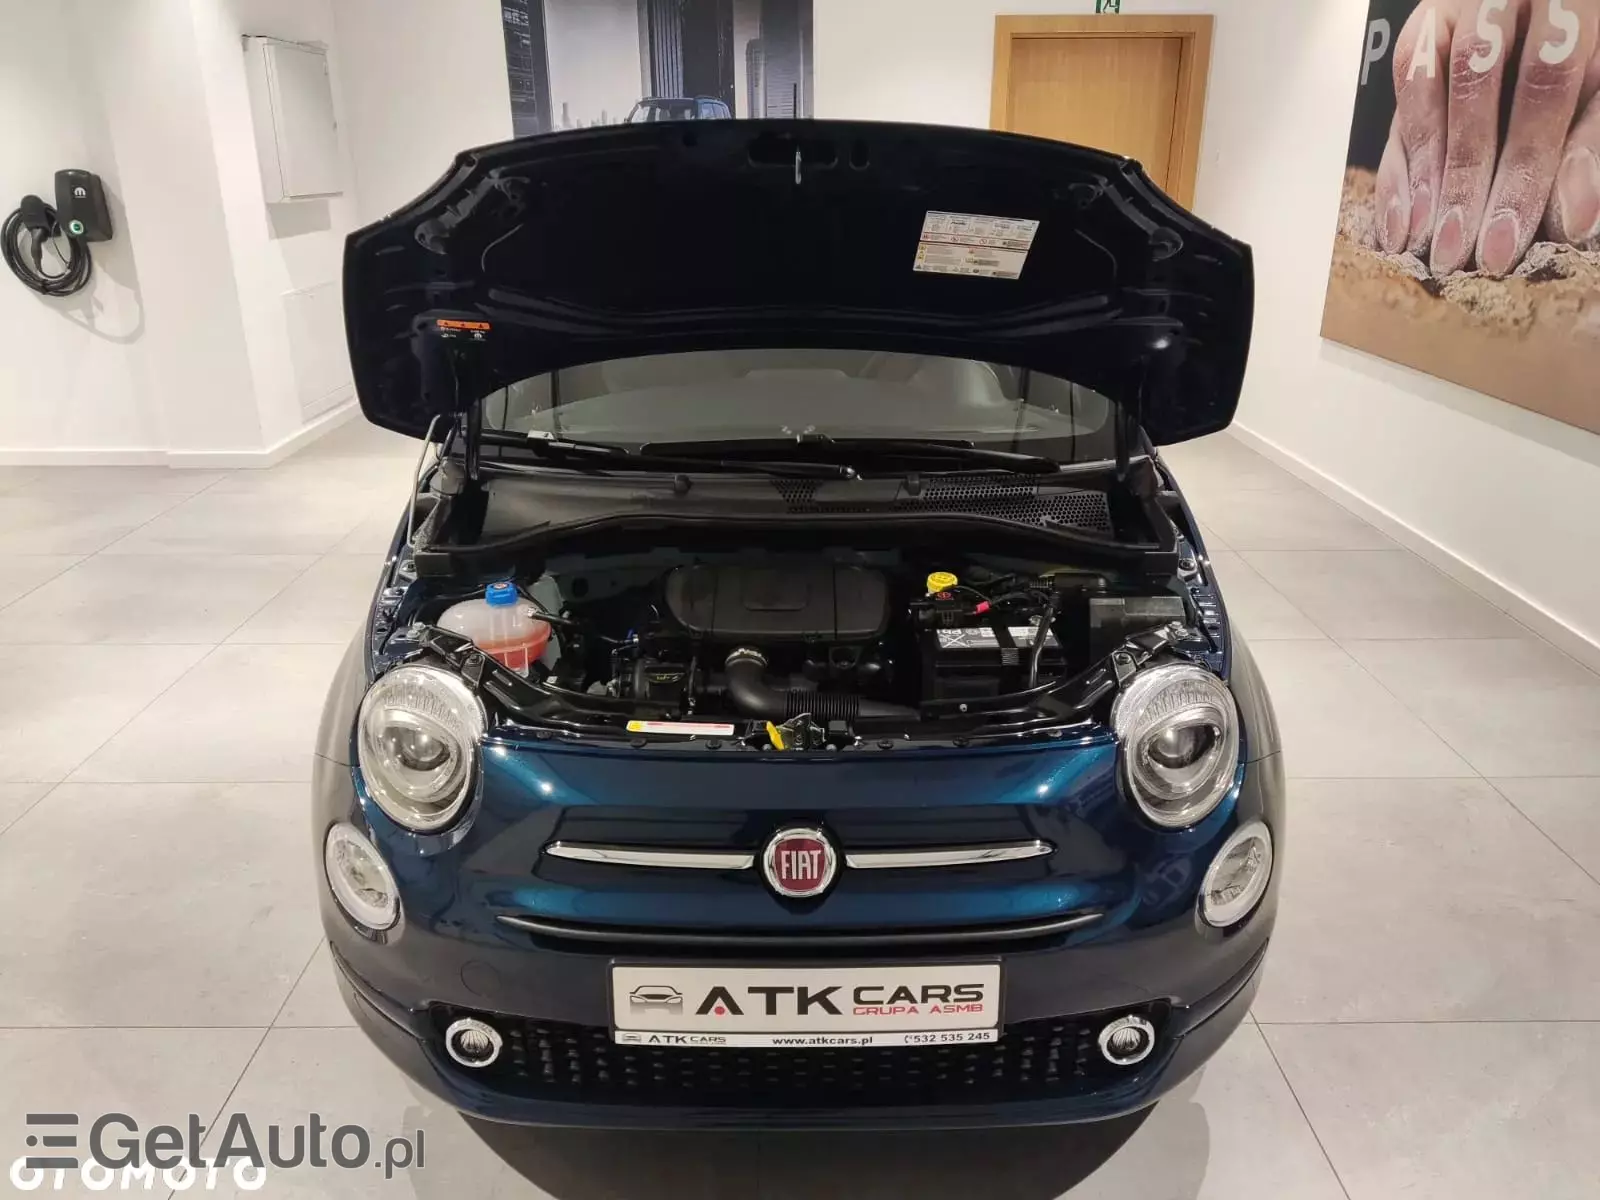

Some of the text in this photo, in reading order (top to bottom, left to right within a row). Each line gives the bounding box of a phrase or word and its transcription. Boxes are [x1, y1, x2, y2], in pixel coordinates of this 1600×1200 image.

[781, 850, 821, 880] FIAT
[695, 984, 985, 1015] ATK CARS
[853, 1004, 984, 1016] GRUPA ASMB
[648, 1035, 727, 1045] ATK CARS
[772, 1036, 873, 1046] www.atkcars.pl
[914, 1032, 991, 1043] 532 535 245
